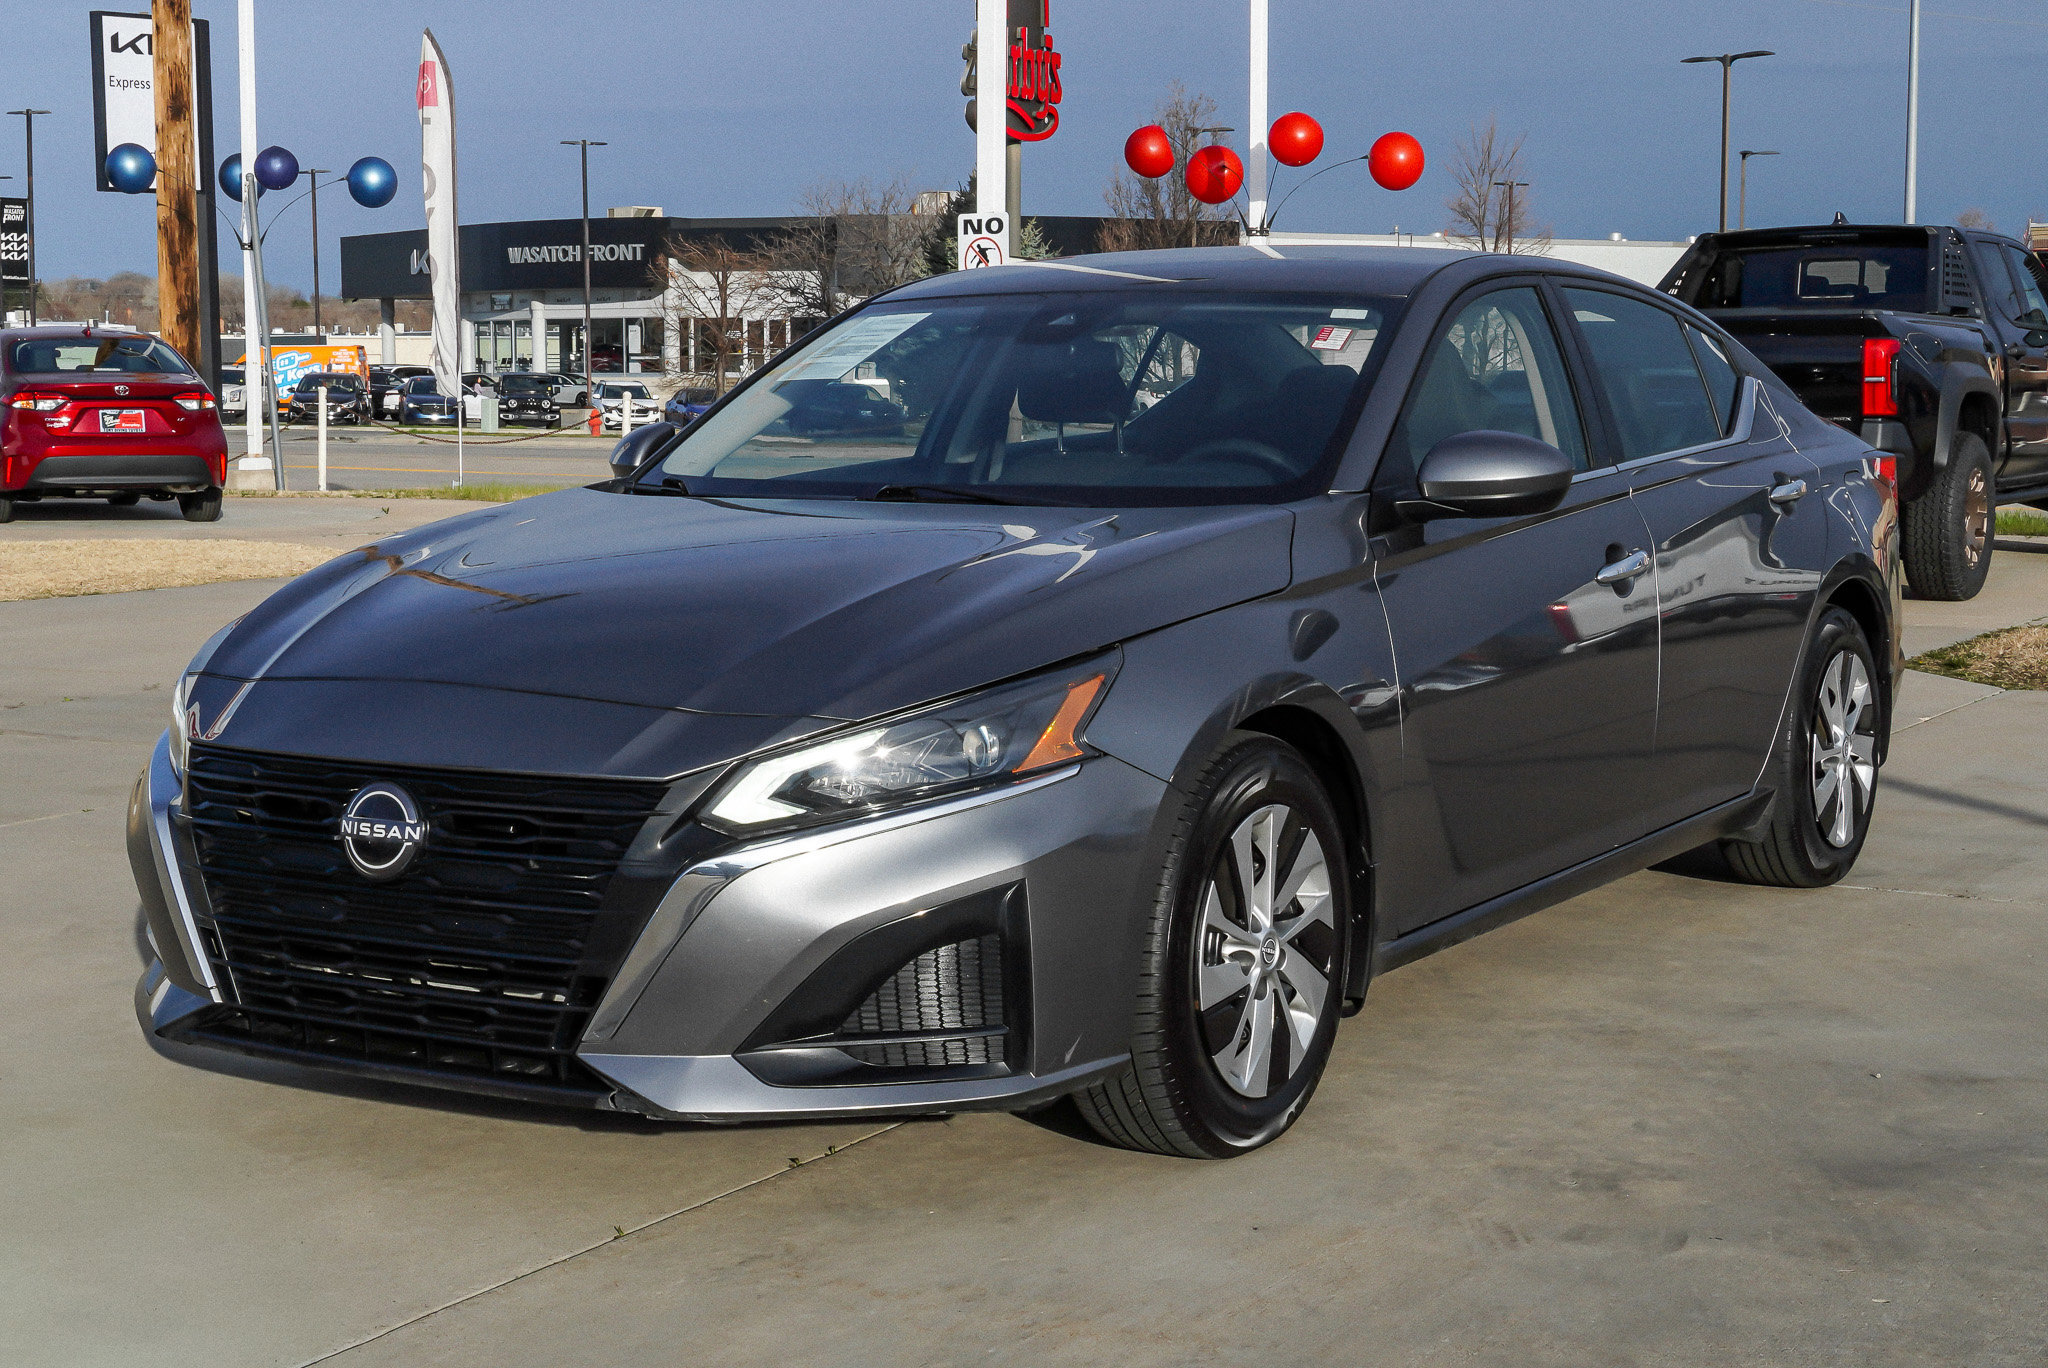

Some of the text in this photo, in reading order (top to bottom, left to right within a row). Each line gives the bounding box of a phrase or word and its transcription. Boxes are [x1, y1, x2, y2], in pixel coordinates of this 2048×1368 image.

[110, 31, 153, 55] KI
[109, 75, 151, 91] Express
[3, 214, 24, 224] FRONT
[963, 217, 1004, 235] NO
[508, 245, 581, 264] WASATCH
[341, 819, 421, 841] NISSAN
